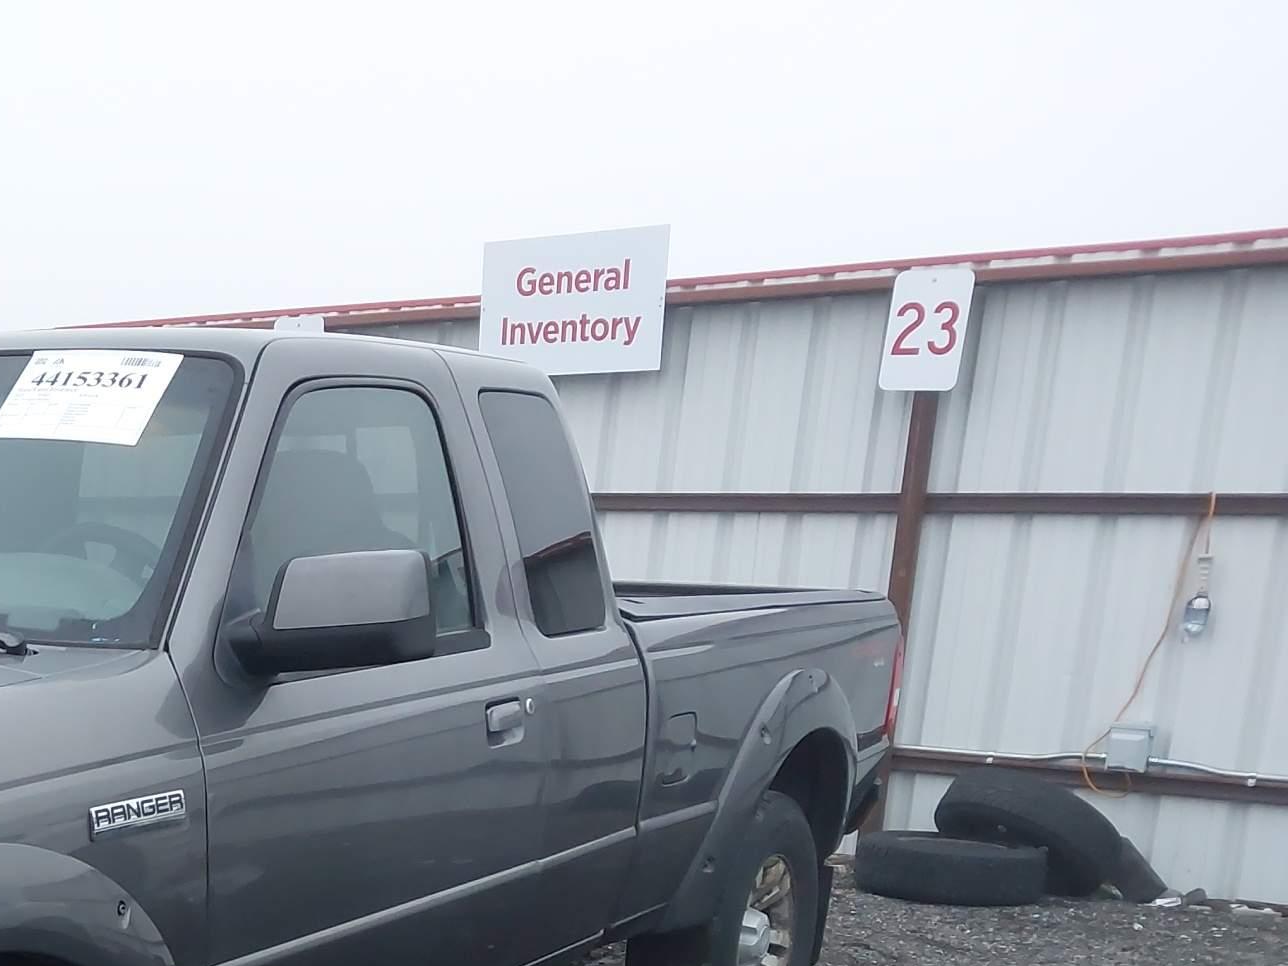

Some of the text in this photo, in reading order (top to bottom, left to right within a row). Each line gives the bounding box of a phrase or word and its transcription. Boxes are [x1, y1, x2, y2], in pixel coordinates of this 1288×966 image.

[515, 258, 631, 297] General
[500, 312, 641, 348] Inventory
[890, 300, 961, 357] 23
[31, 370, 149, 390] 44153361
[94, 793, 184, 828] RANGER
